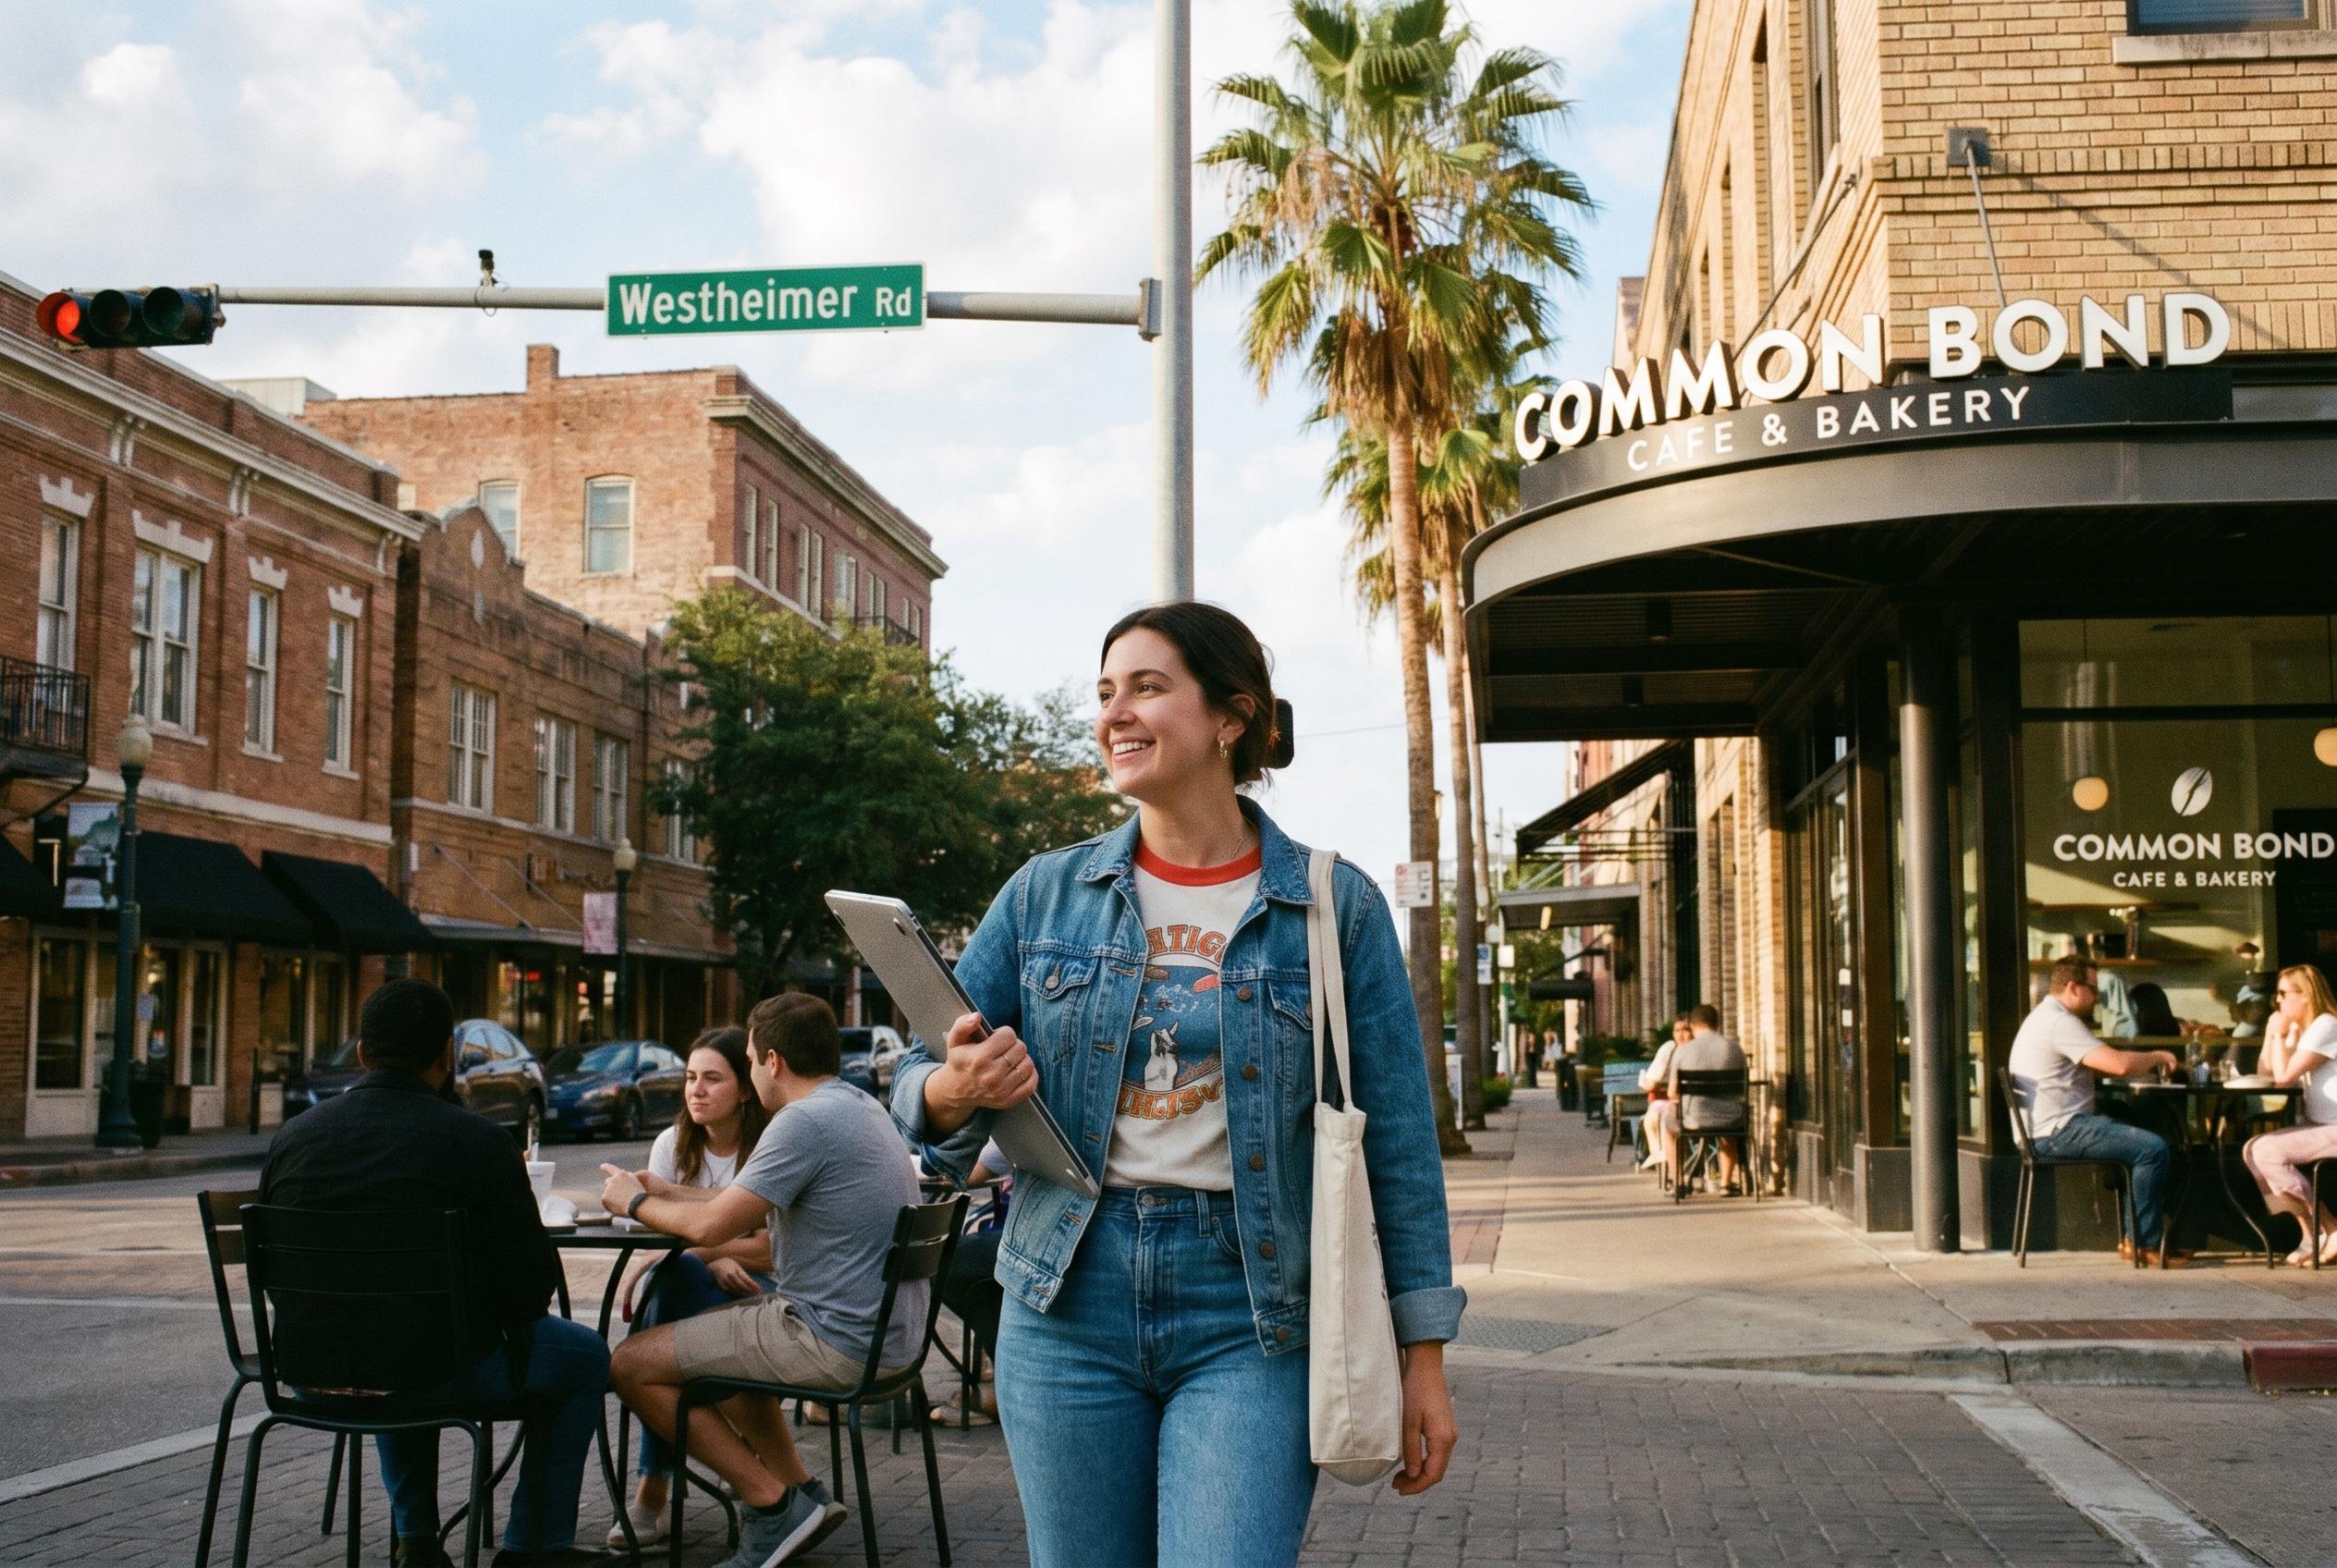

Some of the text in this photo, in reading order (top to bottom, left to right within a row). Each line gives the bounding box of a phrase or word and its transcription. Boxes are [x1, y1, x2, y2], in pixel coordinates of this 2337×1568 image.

[618, 277, 912, 325] Westheimer Rd
[1514, 292, 2232, 467] COMMON BOND
[1627, 386, 2030, 472] CAFE & BAKERY
[2052, 832, 2335, 862] COMMON BOND
[2112, 871, 2276, 888] CAFE & BAKERY
